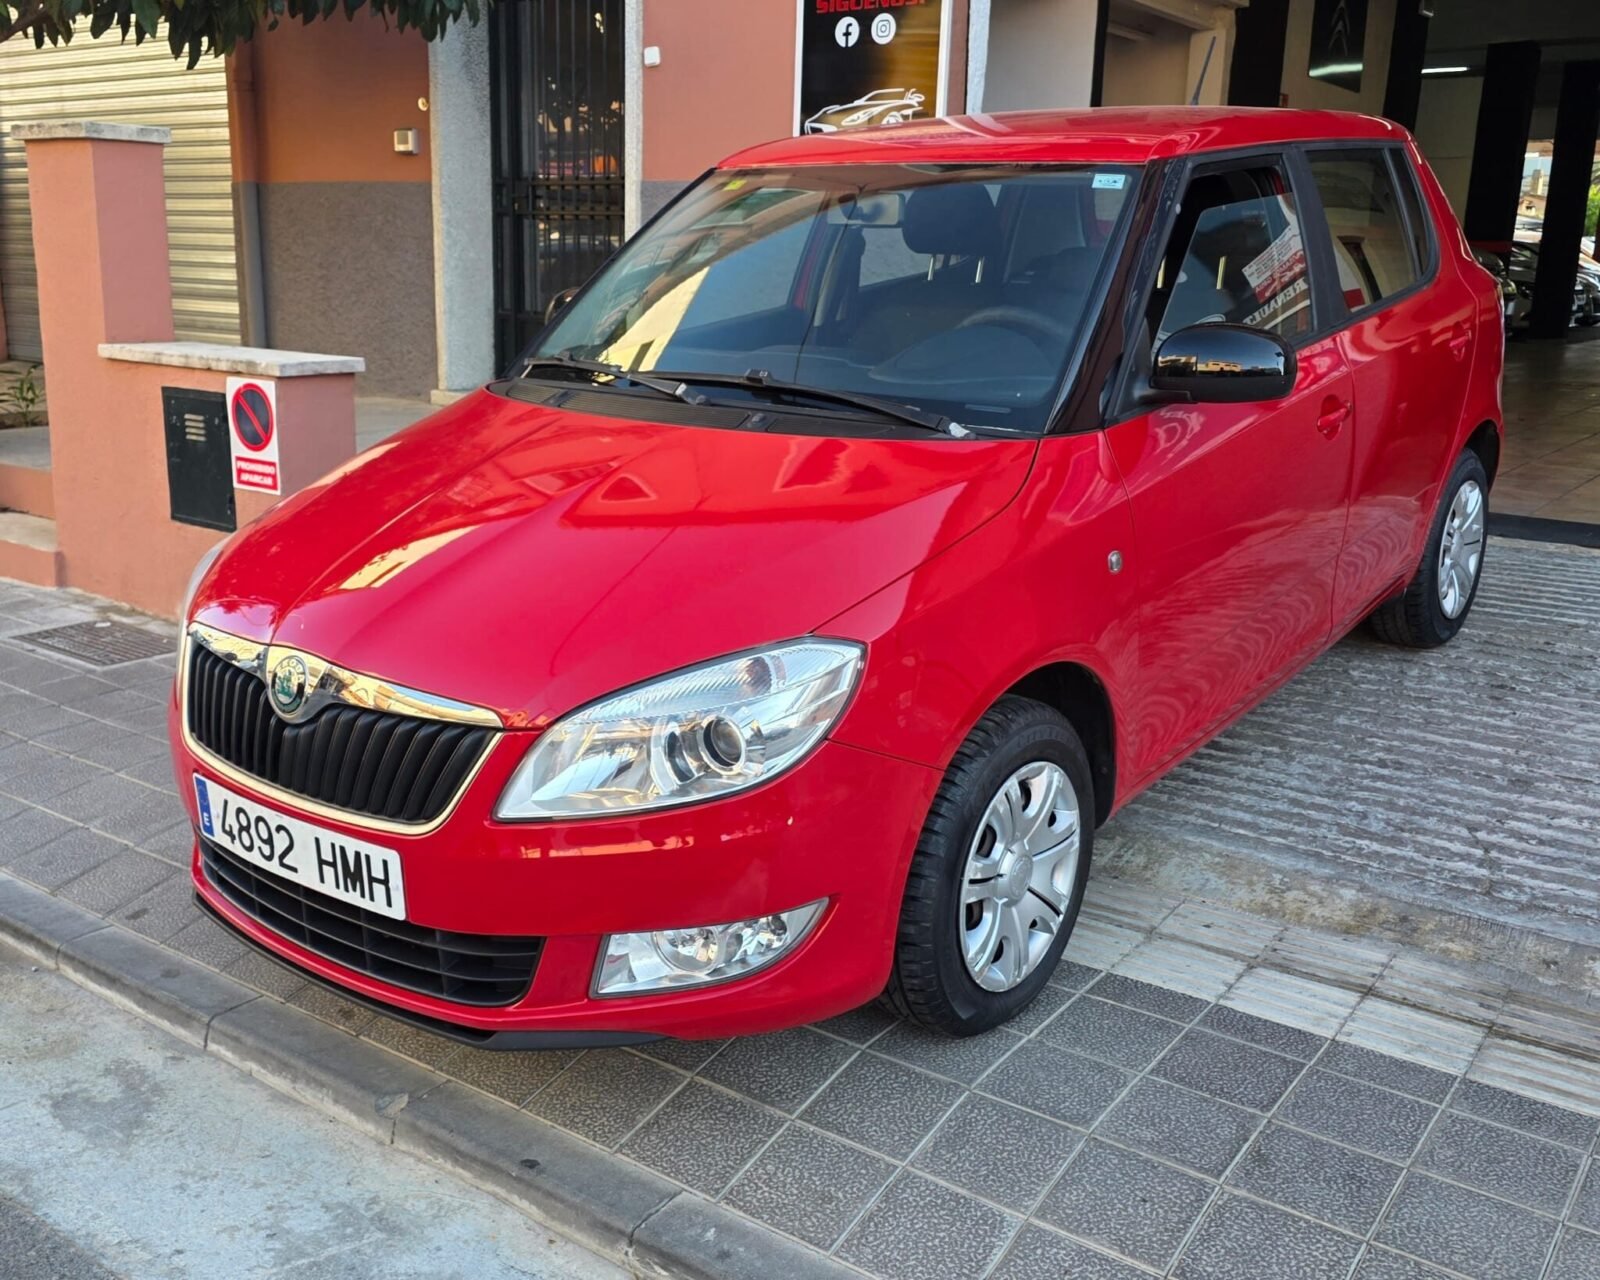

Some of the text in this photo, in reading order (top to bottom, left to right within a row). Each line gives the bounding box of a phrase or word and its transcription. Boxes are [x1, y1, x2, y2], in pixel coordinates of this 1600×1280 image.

[816, 0, 925, 14] SIGUEN
[236, 460, 276, 476] PROHIBIDO
[240, 472, 274, 486] APARCAR
[202, 812, 211, 827] E
[220, 798, 393, 909] 4892 HMH
